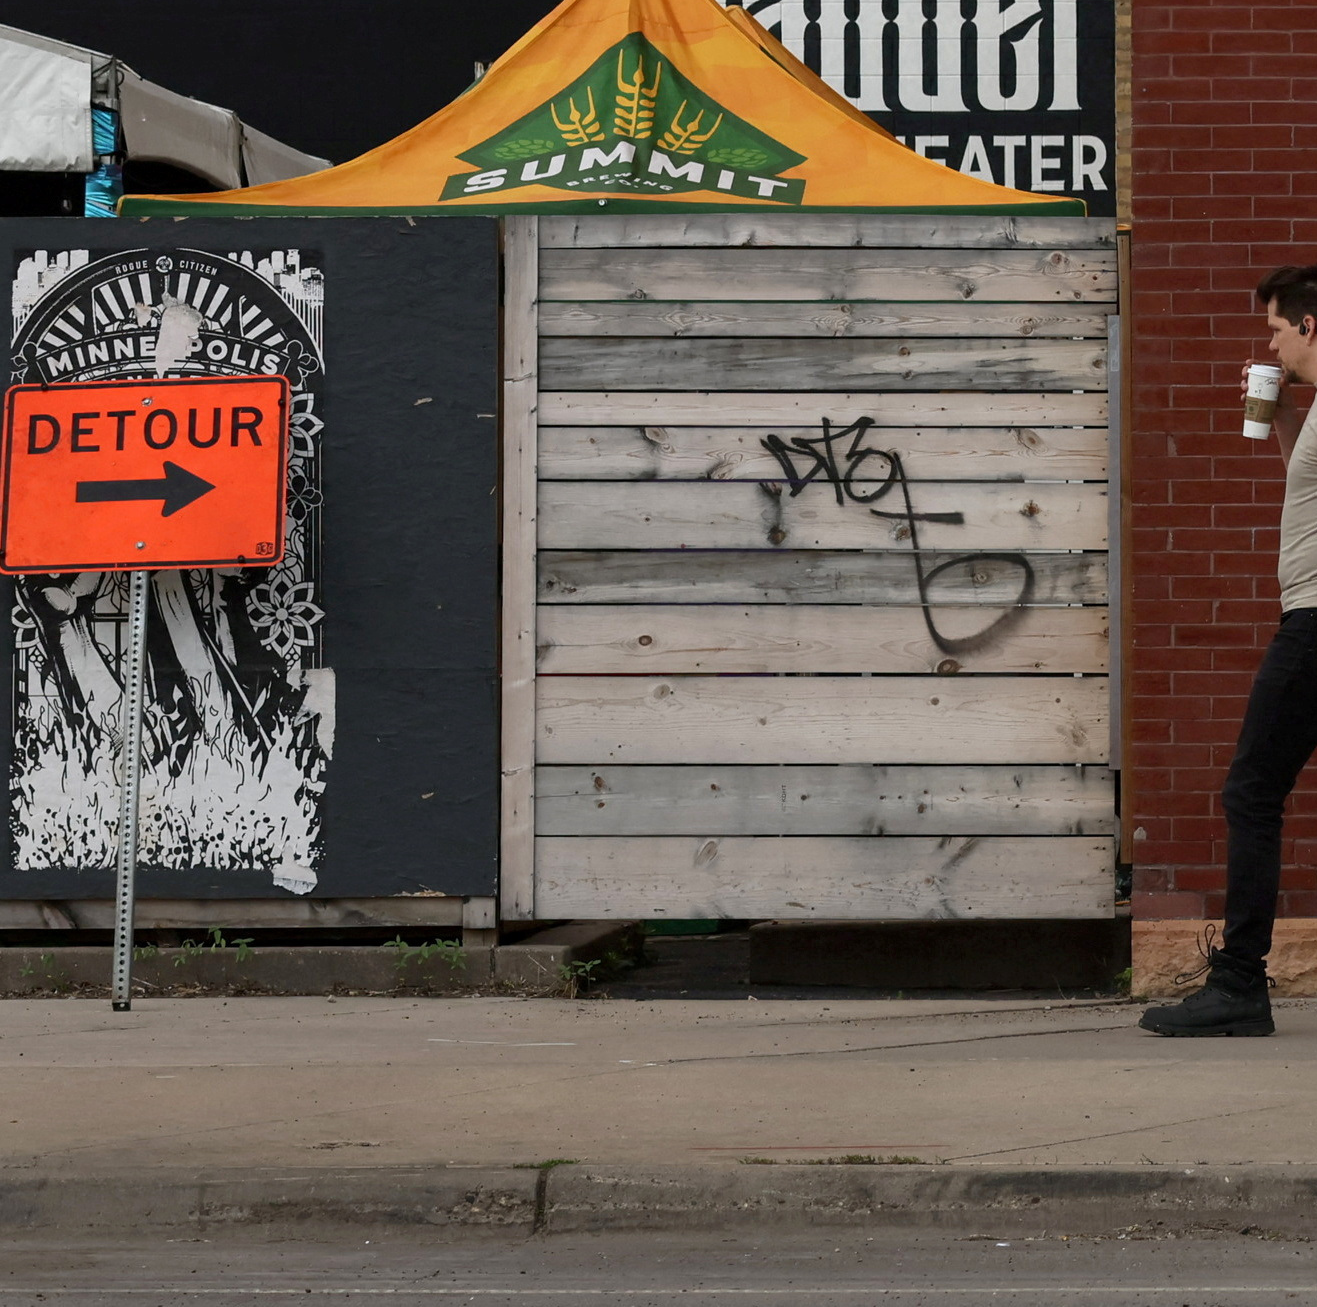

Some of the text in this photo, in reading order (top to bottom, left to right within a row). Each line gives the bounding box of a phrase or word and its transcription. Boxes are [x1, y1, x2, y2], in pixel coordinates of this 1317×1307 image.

[463, 141, 788, 197] SUMMIT
[566, 171, 674, 191] BREWING
[115, 259, 218, 276] ROGUE CITIZEN
[46, 335, 282, 378] MINNEPOLIS
[26, 406, 265, 455] DETOUR
